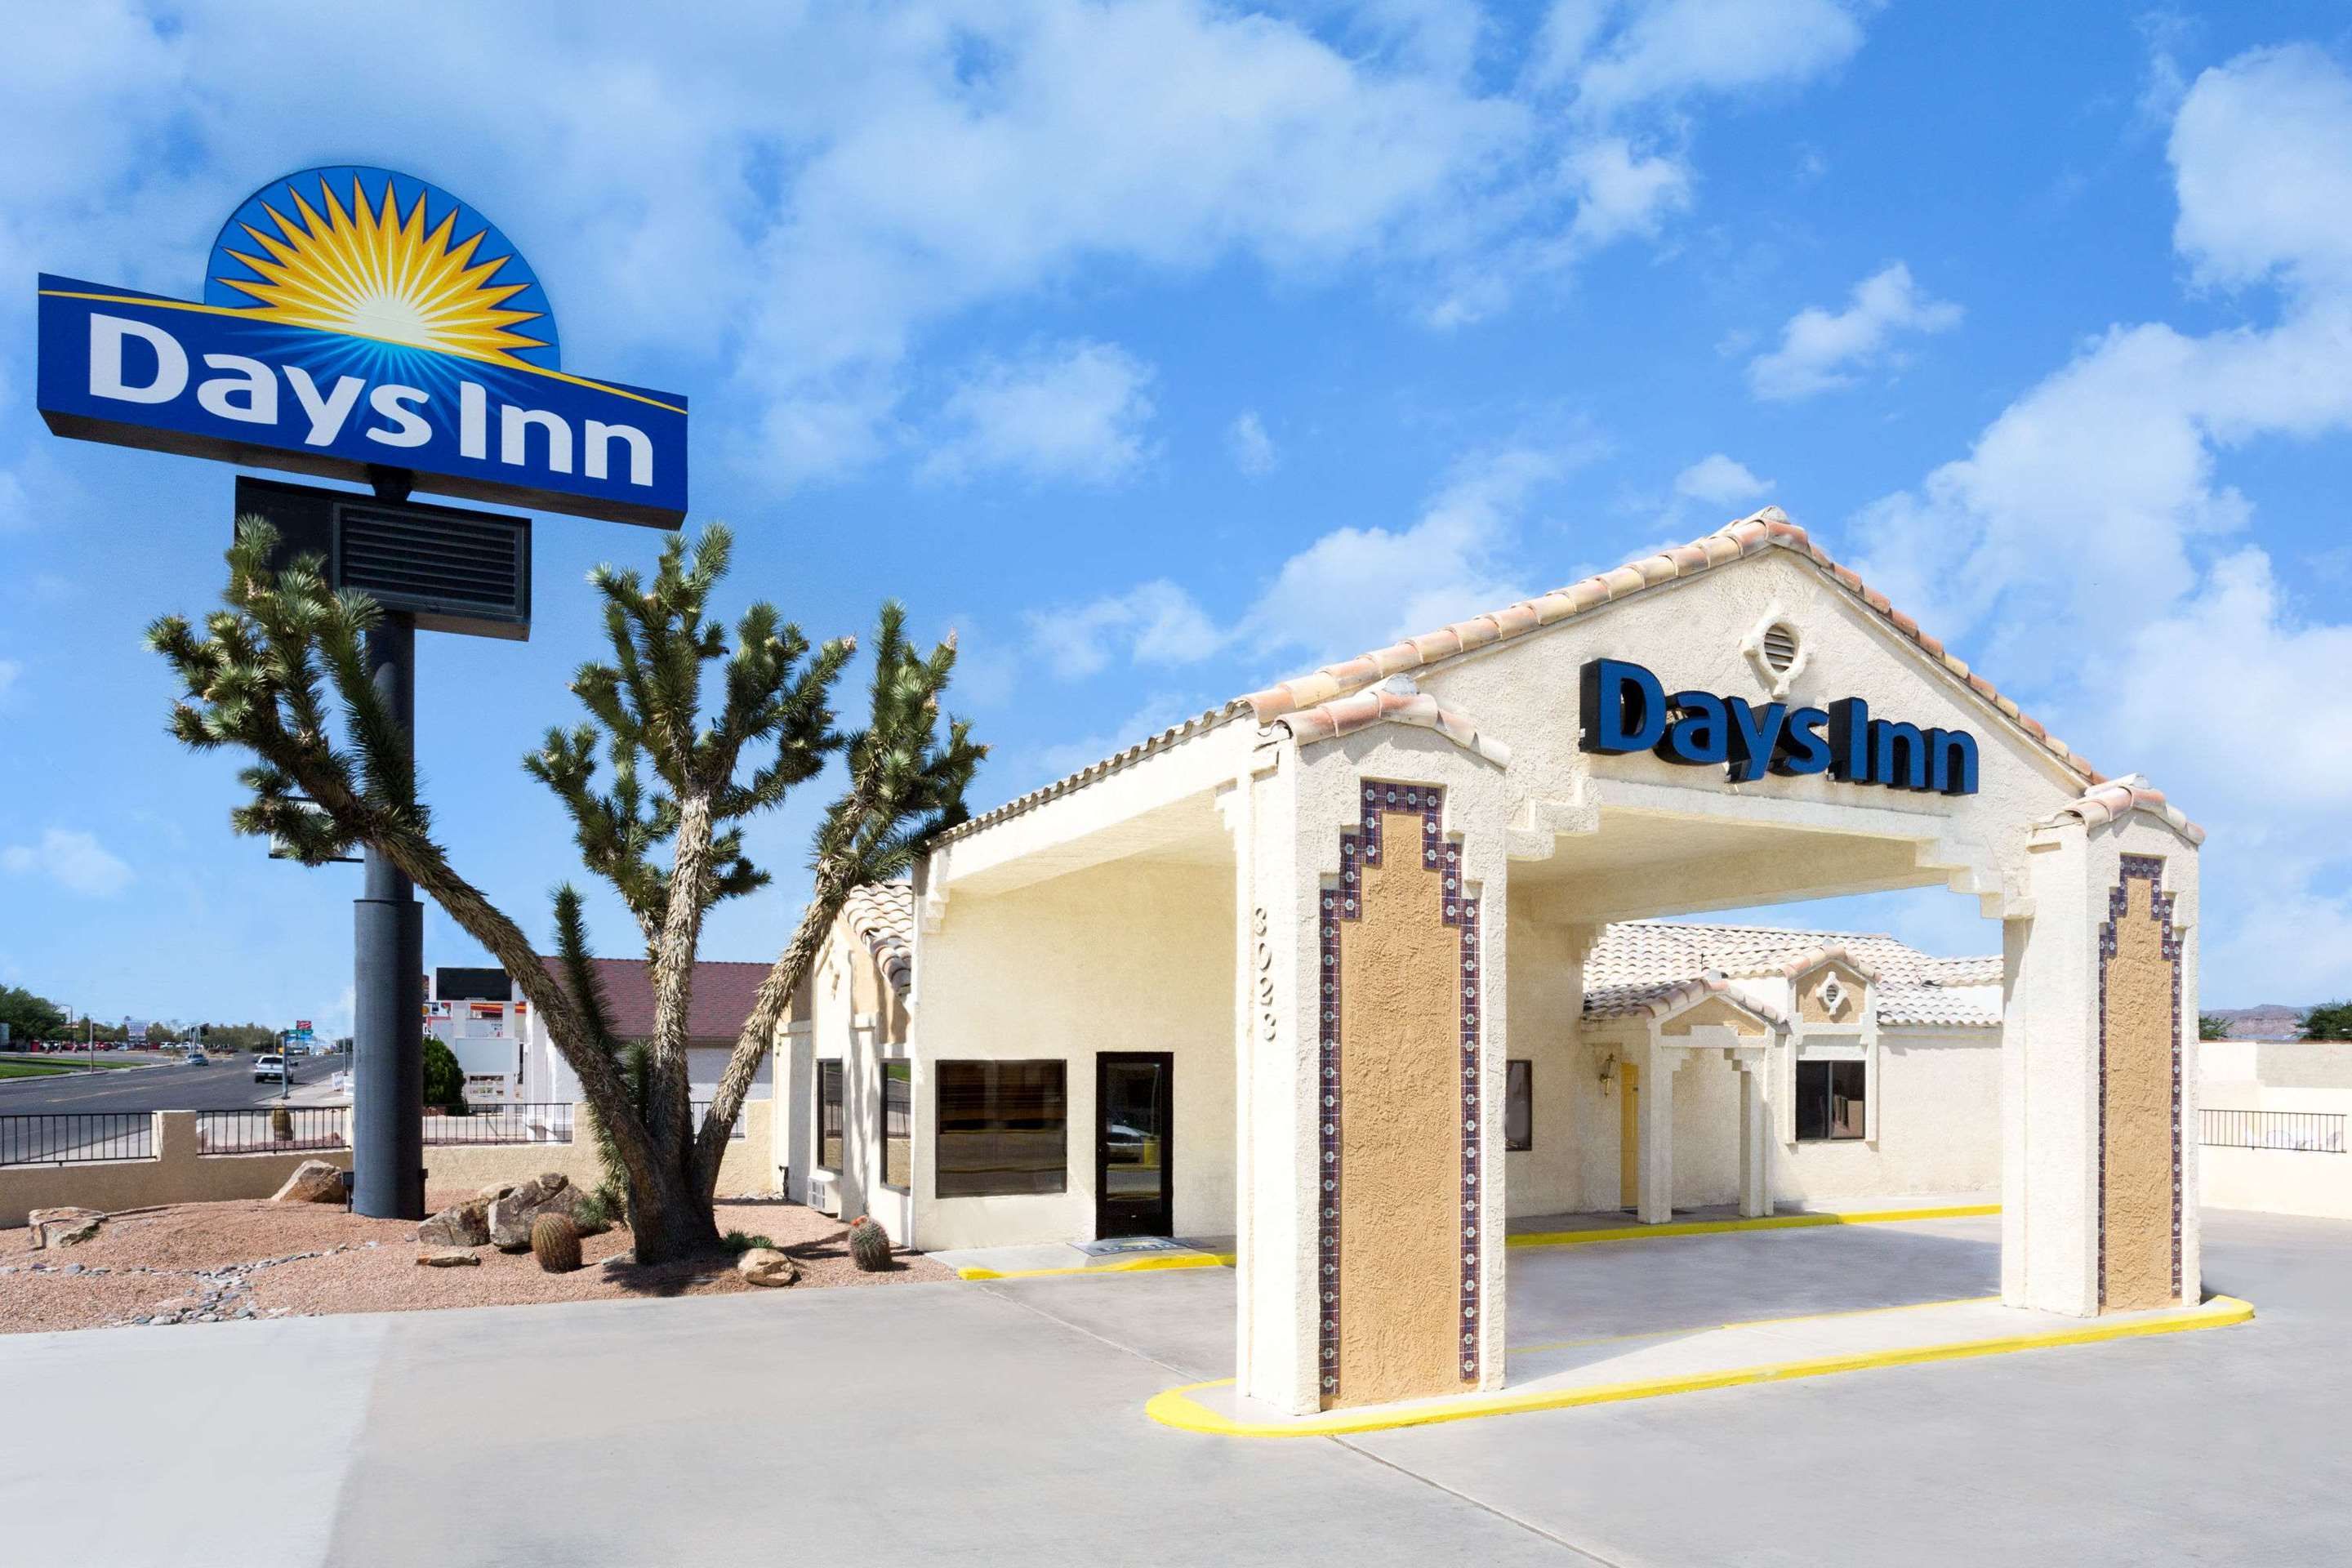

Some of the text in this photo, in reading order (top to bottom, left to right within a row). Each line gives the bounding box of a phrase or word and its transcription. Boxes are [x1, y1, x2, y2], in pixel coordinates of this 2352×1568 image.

[90, 313, 653, 487] Days Inn
[1581, 658, 1979, 794] Days Inn
